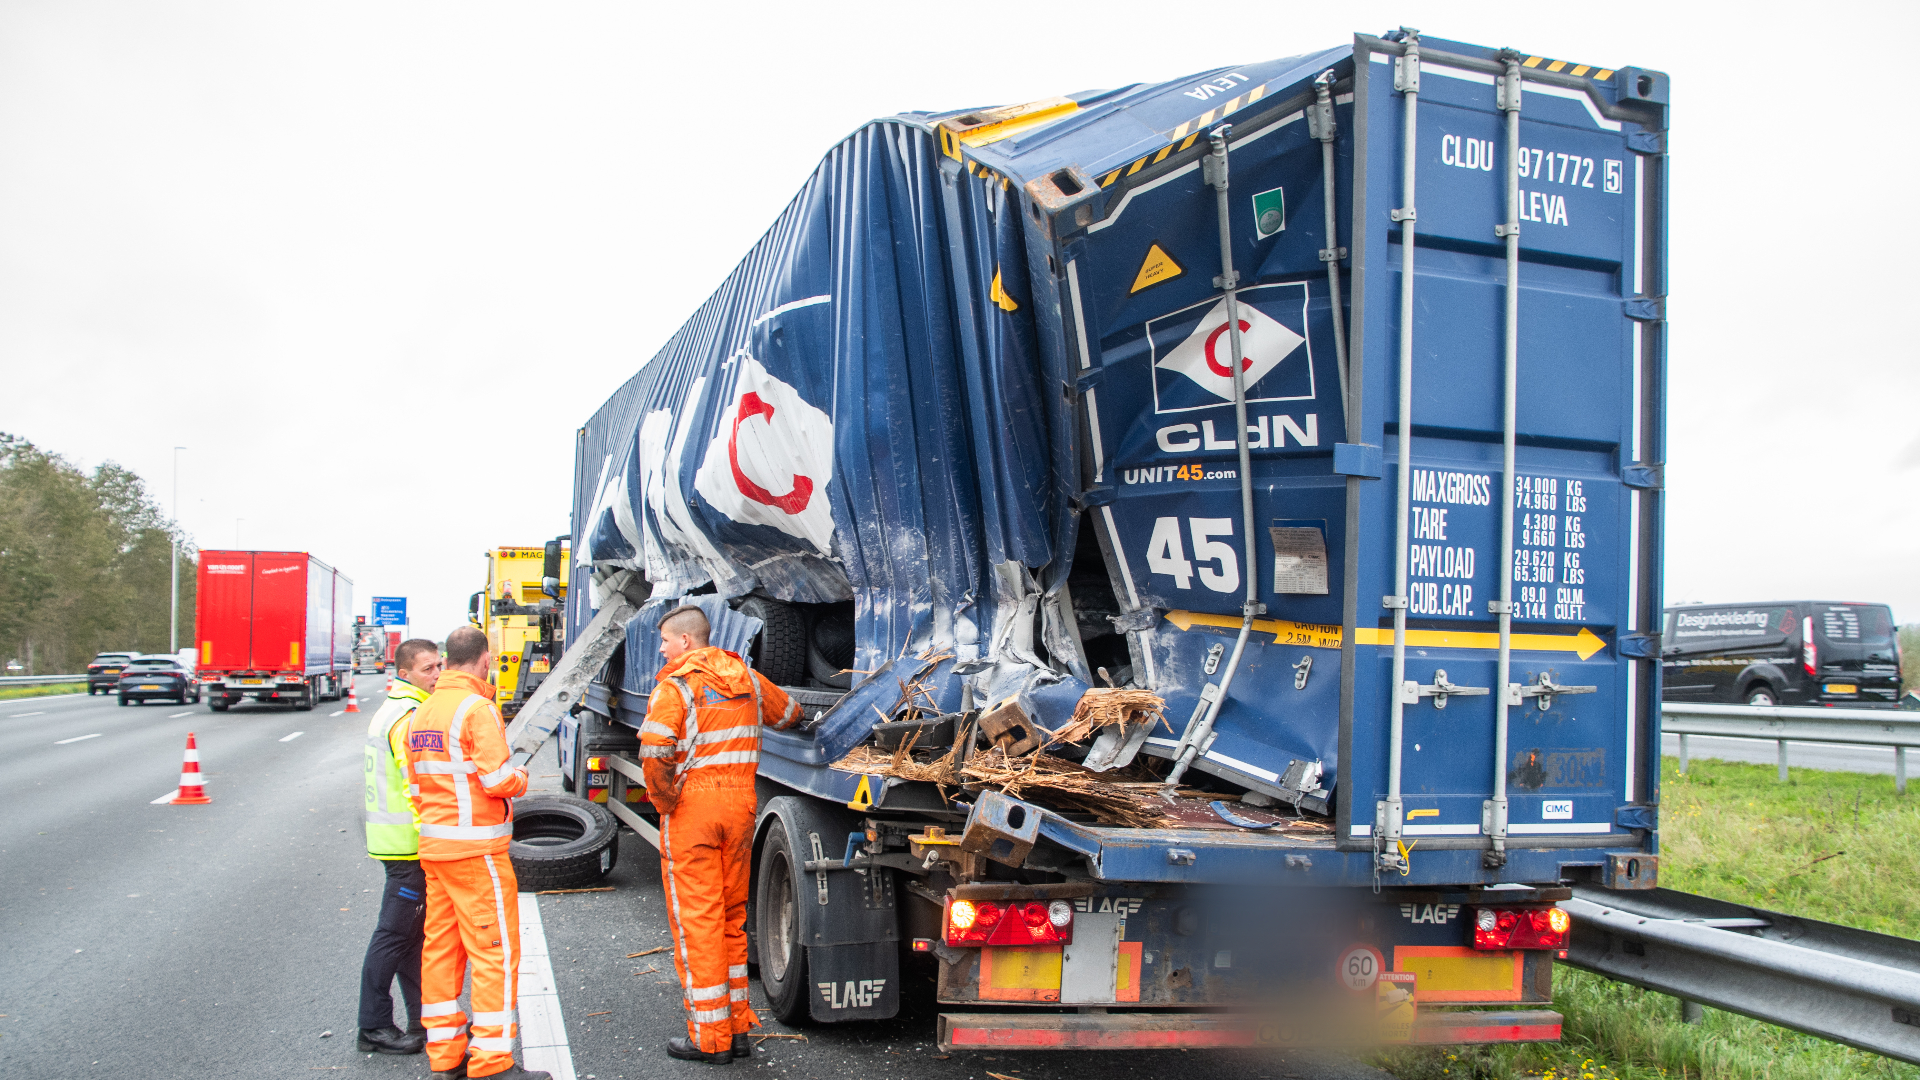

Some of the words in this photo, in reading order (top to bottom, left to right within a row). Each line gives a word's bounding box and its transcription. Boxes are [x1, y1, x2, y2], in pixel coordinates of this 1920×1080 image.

[1183, 72, 1249, 101] LEVA
[1442, 134, 1494, 172] CLDU
[1517, 147, 1594, 189] 971772
[1605, 160, 1620, 192] 5
[1518, 189, 1568, 227] LEVA
[1145, 268, 1164, 280] HEAVY
[1204, 319, 1254, 378] C
[1155, 413, 1319, 453] CLdN
[728, 391, 813, 515] C
[1124, 464, 1237, 485] UNIT45.com
[1412, 469, 1491, 506] MAXGROSS
[1515, 476, 1557, 495] 34.000
[1566, 480, 1583, 497] KG
[1515, 492, 1557, 511] 74.960
[1565, 495, 1587, 513] LBS
[1412, 507, 1448, 541] TARE
[1522, 513, 1556, 531] 4.380
[1565, 515, 1581, 533] KG
[1522, 529, 1556, 547] 9.660
[1564, 532, 1586, 549] LBS
[1145, 516, 1240, 594] 45
[1410, 544, 1475, 579] PAYLOAD
[1514, 549, 1555, 567] 29.620
[1563, 552, 1580, 569] KG
[1514, 565, 1554, 583] 65.300
[1562, 568, 1585, 585] LBS
[1410, 582, 1474, 616] CUB.CAP.
[1521, 586, 1546, 603] 89.0
[1556, 587, 1586, 605] CU.M.
[1513, 602, 1546, 619] 3.144
[1554, 603, 1586, 621] CU.FT.
[1677, 610, 1768, 629] Designbekleding
[1545, 804, 1570, 813] CIMC
[1087, 896, 1128, 919] LAG
[1411, 903, 1447, 924] LAG
[1348, 955, 1372, 976] 60
[1352, 977, 1366, 987] km
[1379, 973, 1415, 981] ATTENTION
[831, 979, 873, 1009] LAG
[1380, 1022, 1410, 1030] ANGLES
